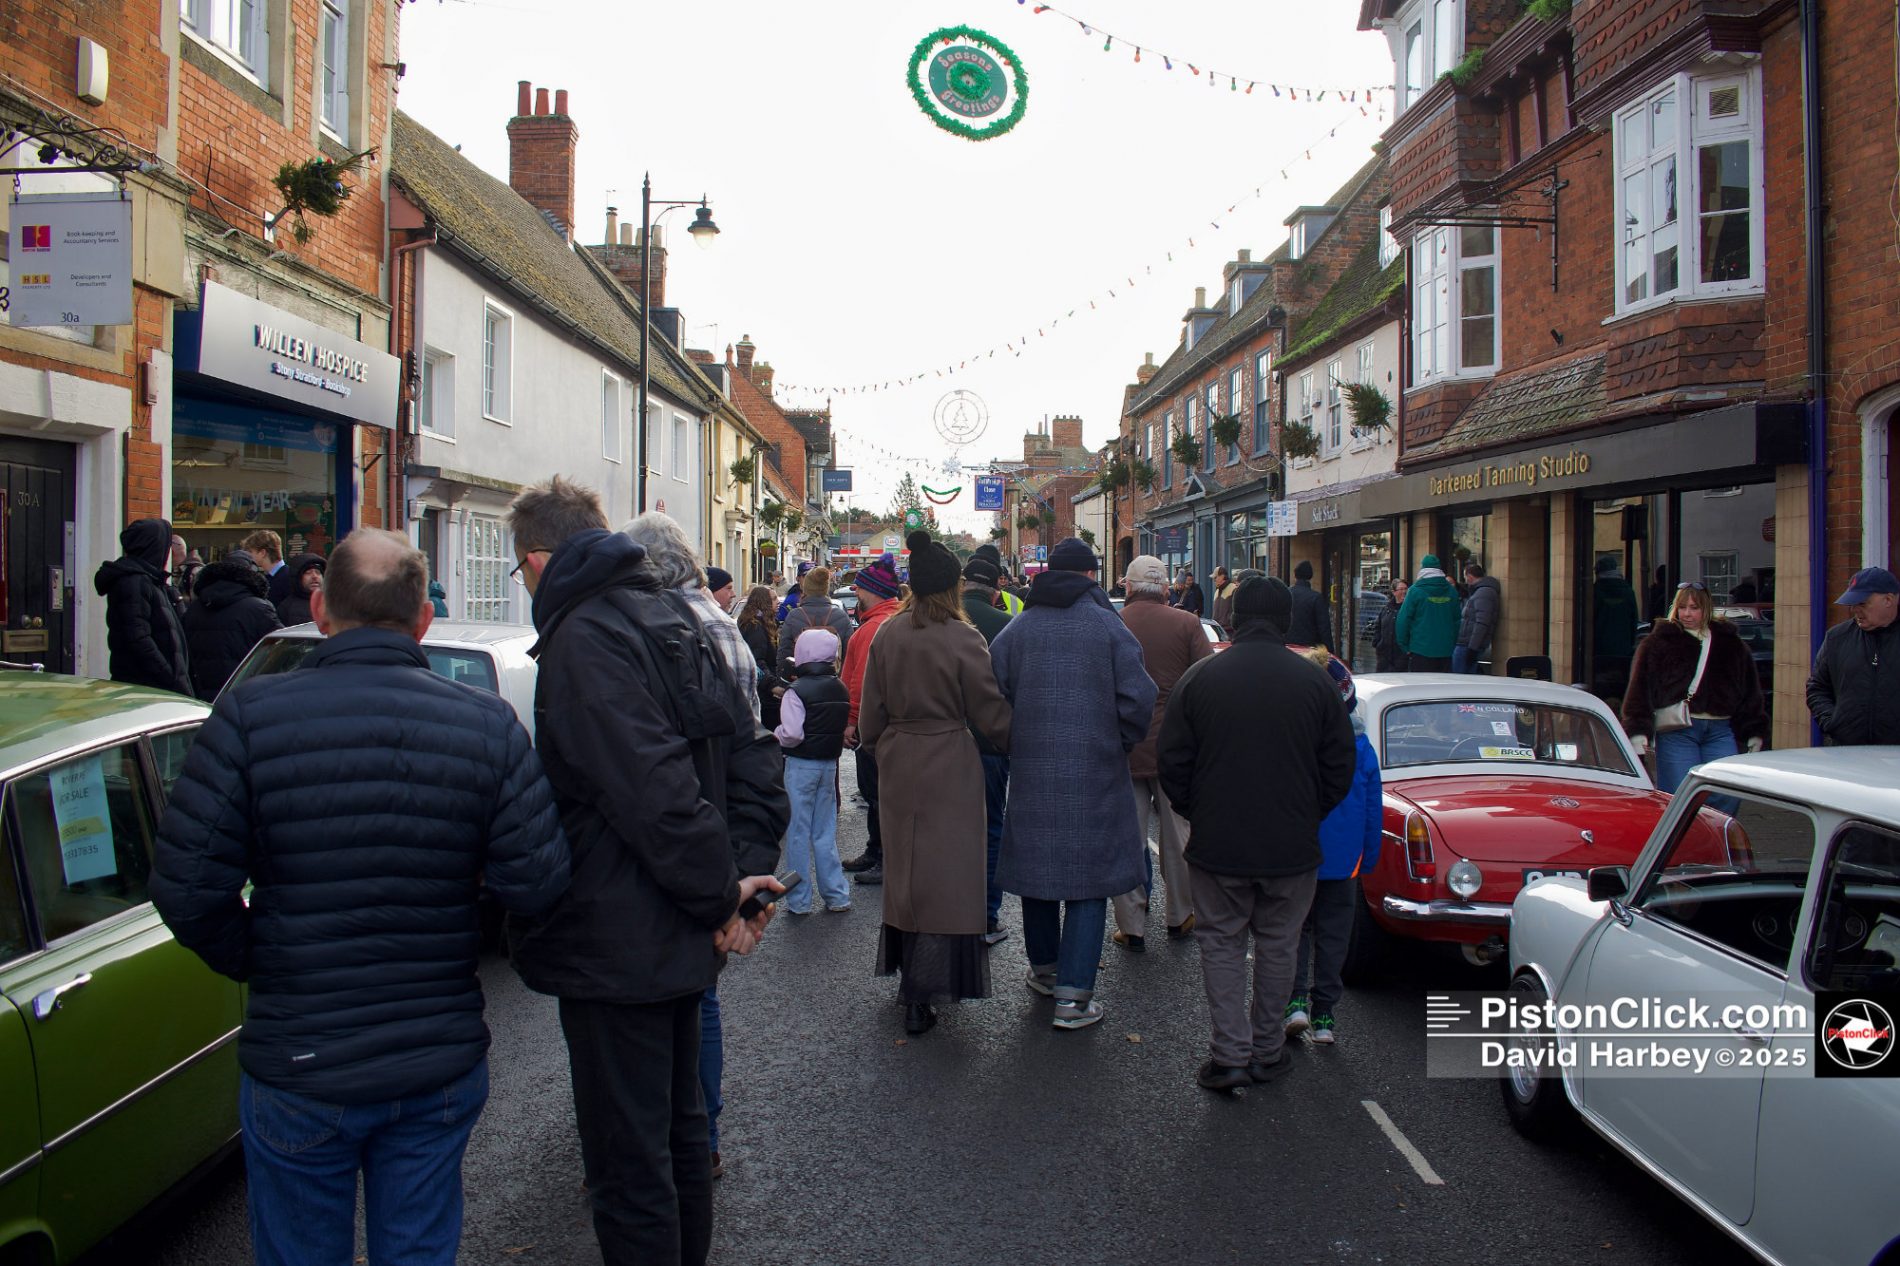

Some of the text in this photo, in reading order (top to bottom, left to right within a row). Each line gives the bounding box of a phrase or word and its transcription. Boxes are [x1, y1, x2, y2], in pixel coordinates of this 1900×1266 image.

[941, 90, 1000, 113] Greetings
[61, 312, 79, 322] 30a
[257, 324, 369, 382] WILLEN HOSPICE
[274, 362, 295, 379] Stony
[294, 368, 323, 386] Stratford
[1430, 450, 1590, 496] Darkened Tanning Studio
[18, 491, 40, 508] 30A
[251, 489, 291, 513] YEAR
[1500, 748, 1533, 757] BRSCC
[71, 788, 89, 800] SALE
